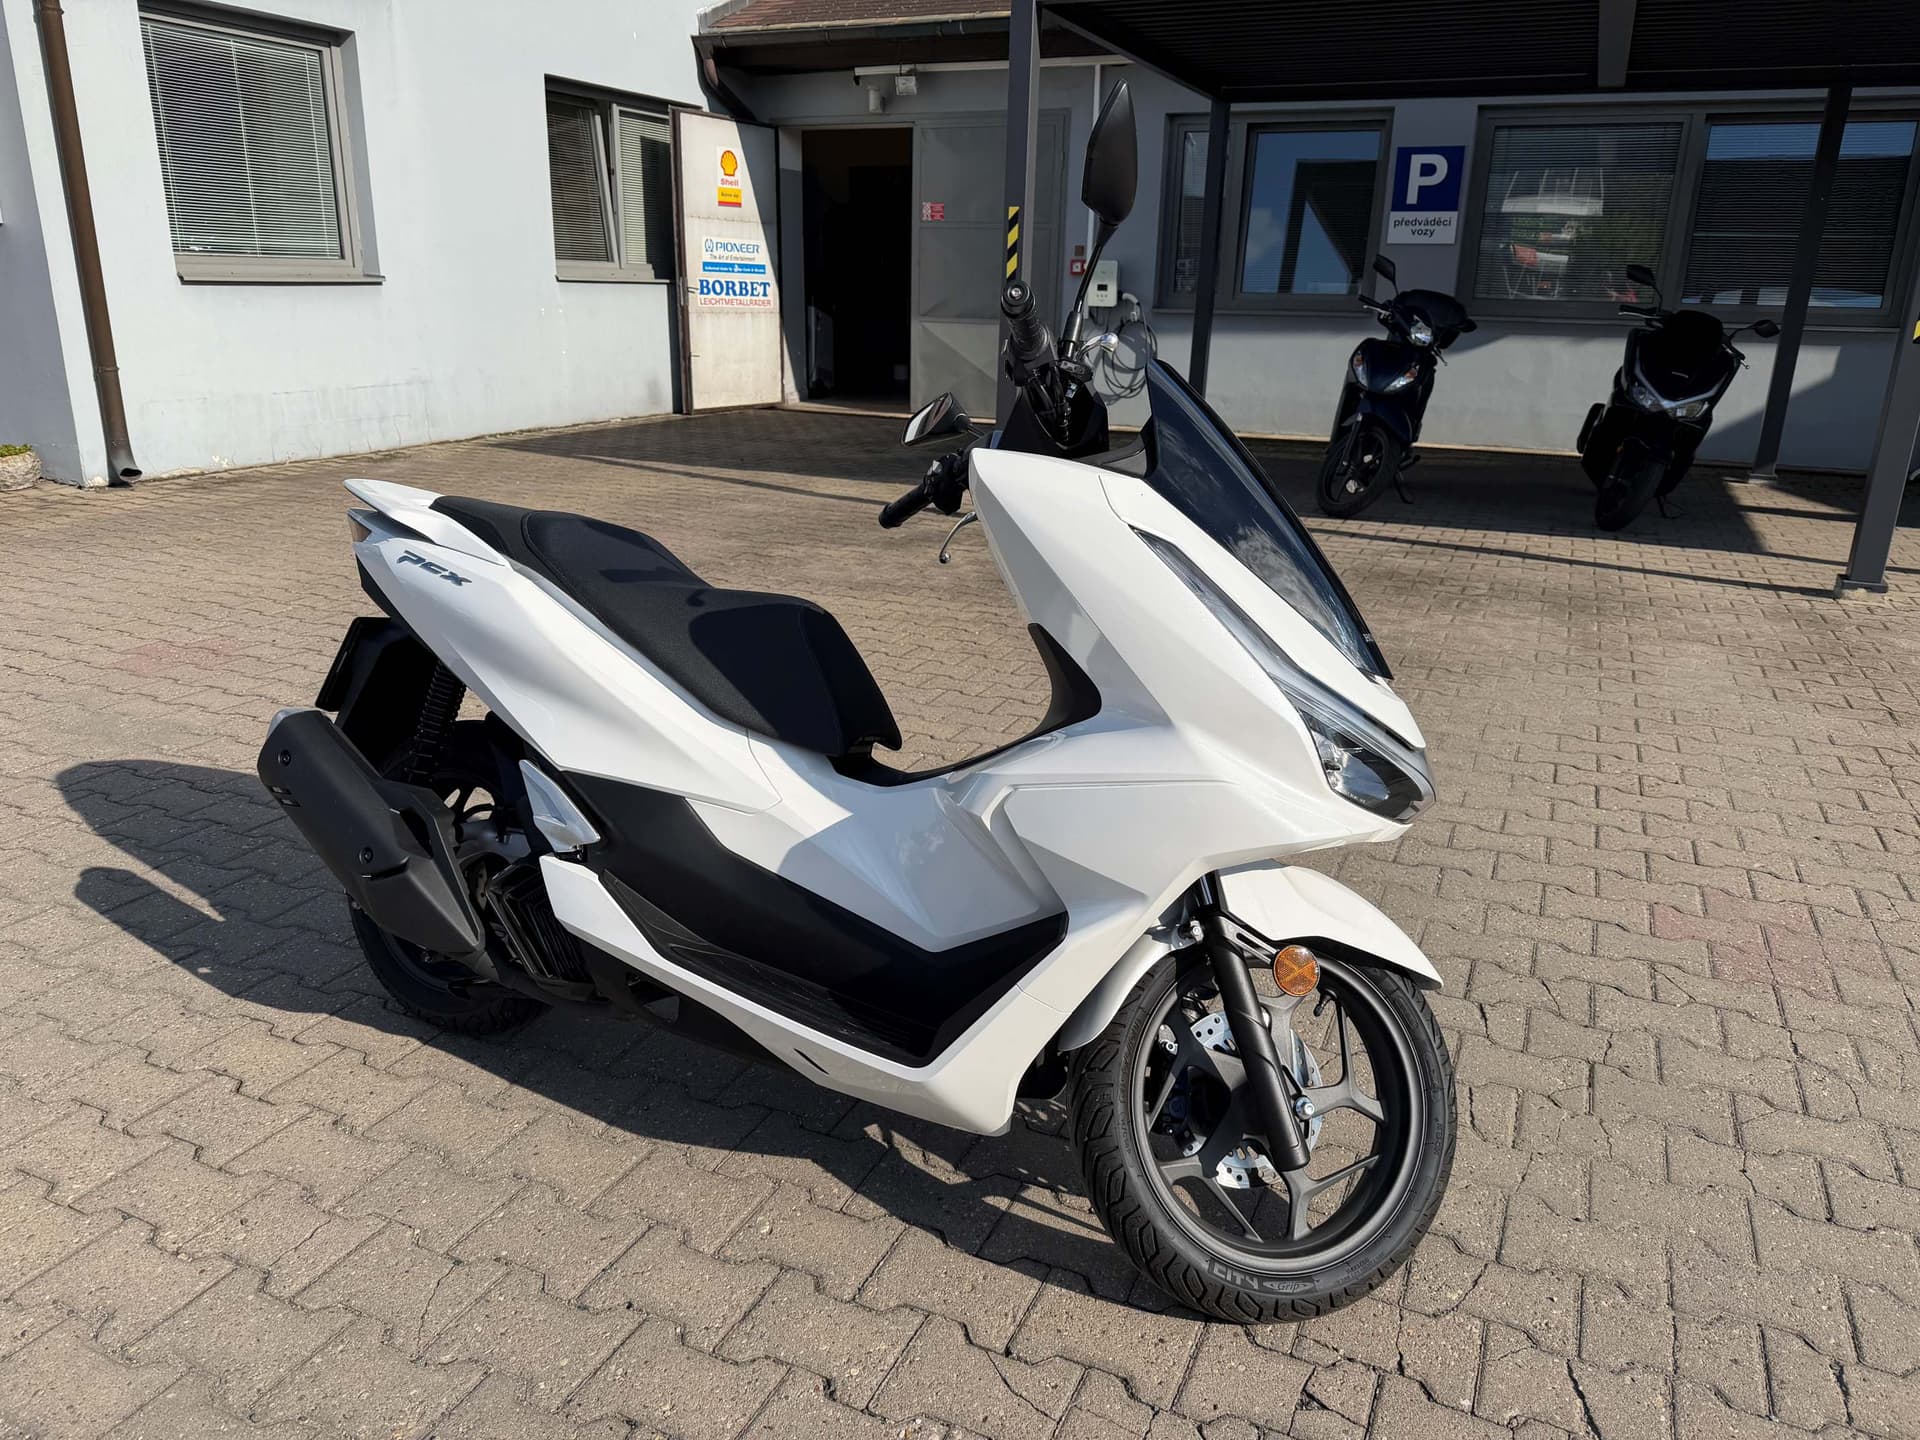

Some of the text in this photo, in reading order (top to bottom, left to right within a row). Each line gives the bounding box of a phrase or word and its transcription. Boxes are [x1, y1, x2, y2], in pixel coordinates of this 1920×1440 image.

[720, 178, 739, 186] Shell
[1406, 153, 1448, 205] P
[1411, 228, 1436, 238] vozy
[715, 241, 760, 254] PIONEER
[698, 279, 771, 297] BORBET
[396, 549, 473, 586] PCX
[1213, 1261, 1259, 1291] CITY
